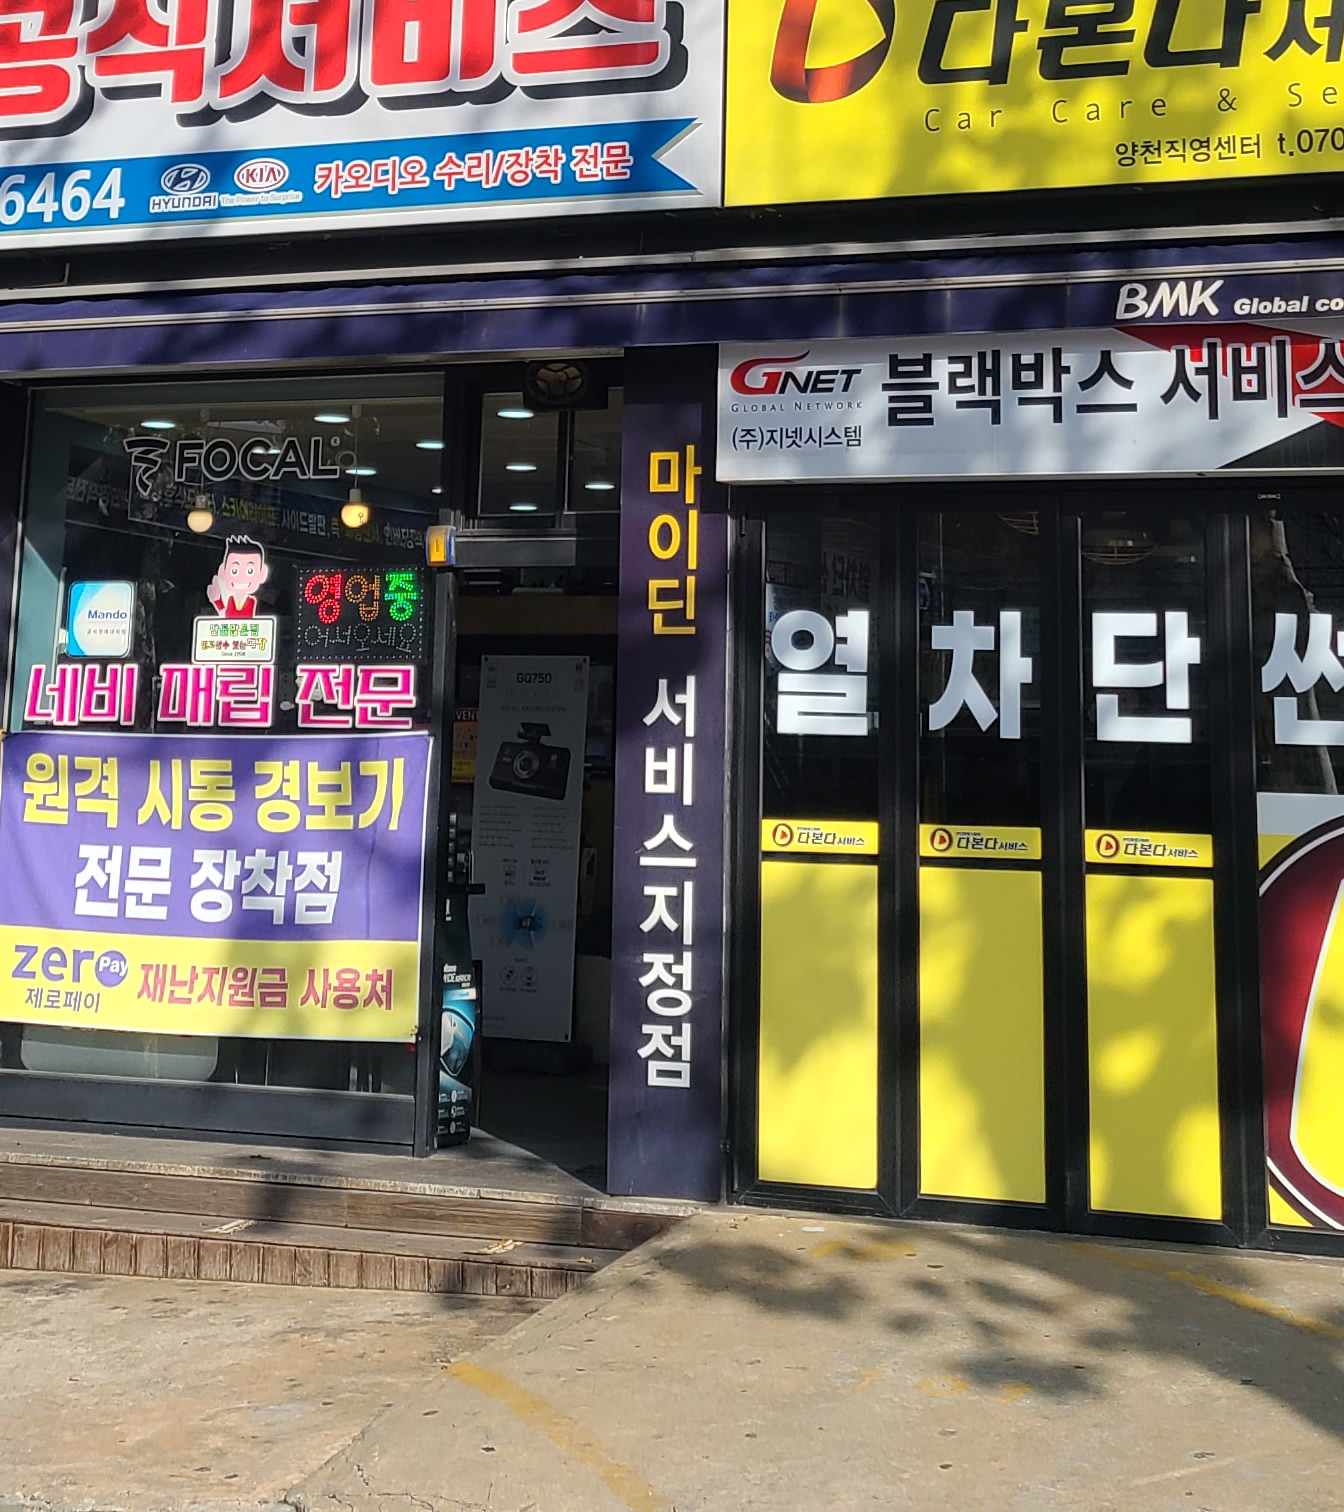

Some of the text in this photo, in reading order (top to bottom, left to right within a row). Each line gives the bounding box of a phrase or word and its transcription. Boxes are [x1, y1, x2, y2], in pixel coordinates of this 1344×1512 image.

[925, 104, 1004, 133] Car
[1052, 94, 1169, 124] Care
[1217, 89, 1237, 113] &
[314, 140, 631, 196] 카오디오 수리/장착 전문
[1115, 132, 1264, 167] 양천직영센터
[150, 195, 218, 212] HYUNDAI
[1117, 278, 1223, 321] BMK
[1234, 297, 1310, 316] Global
[731, 350, 862, 397] GNET
[881, 348, 1137, 427] 블랙박스
[732, 423, 863, 451] (주)지넷시스템
[175, 439, 339, 480] FOCAL
[88, 610, 127, 619] Mando
[303, 571, 418, 625] 영업중
[303, 623, 418, 652] 어서오세요
[25, 662, 418, 730] 네비 매립 전문
[516, 673, 552, 683] GQ750
[637, 444, 702, 1089] 마이딘 서비스지정점
[22, 753, 120, 829] 원격
[137, 757, 235, 832] 시동
[255, 759, 405, 832] 경보기
[72, 845, 343, 925] 전문 장착점
[24, 987, 101, 1014] 제로페이
[137, 964, 288, 1010] 재난지원금
[300, 967, 394, 1011] 사용처
